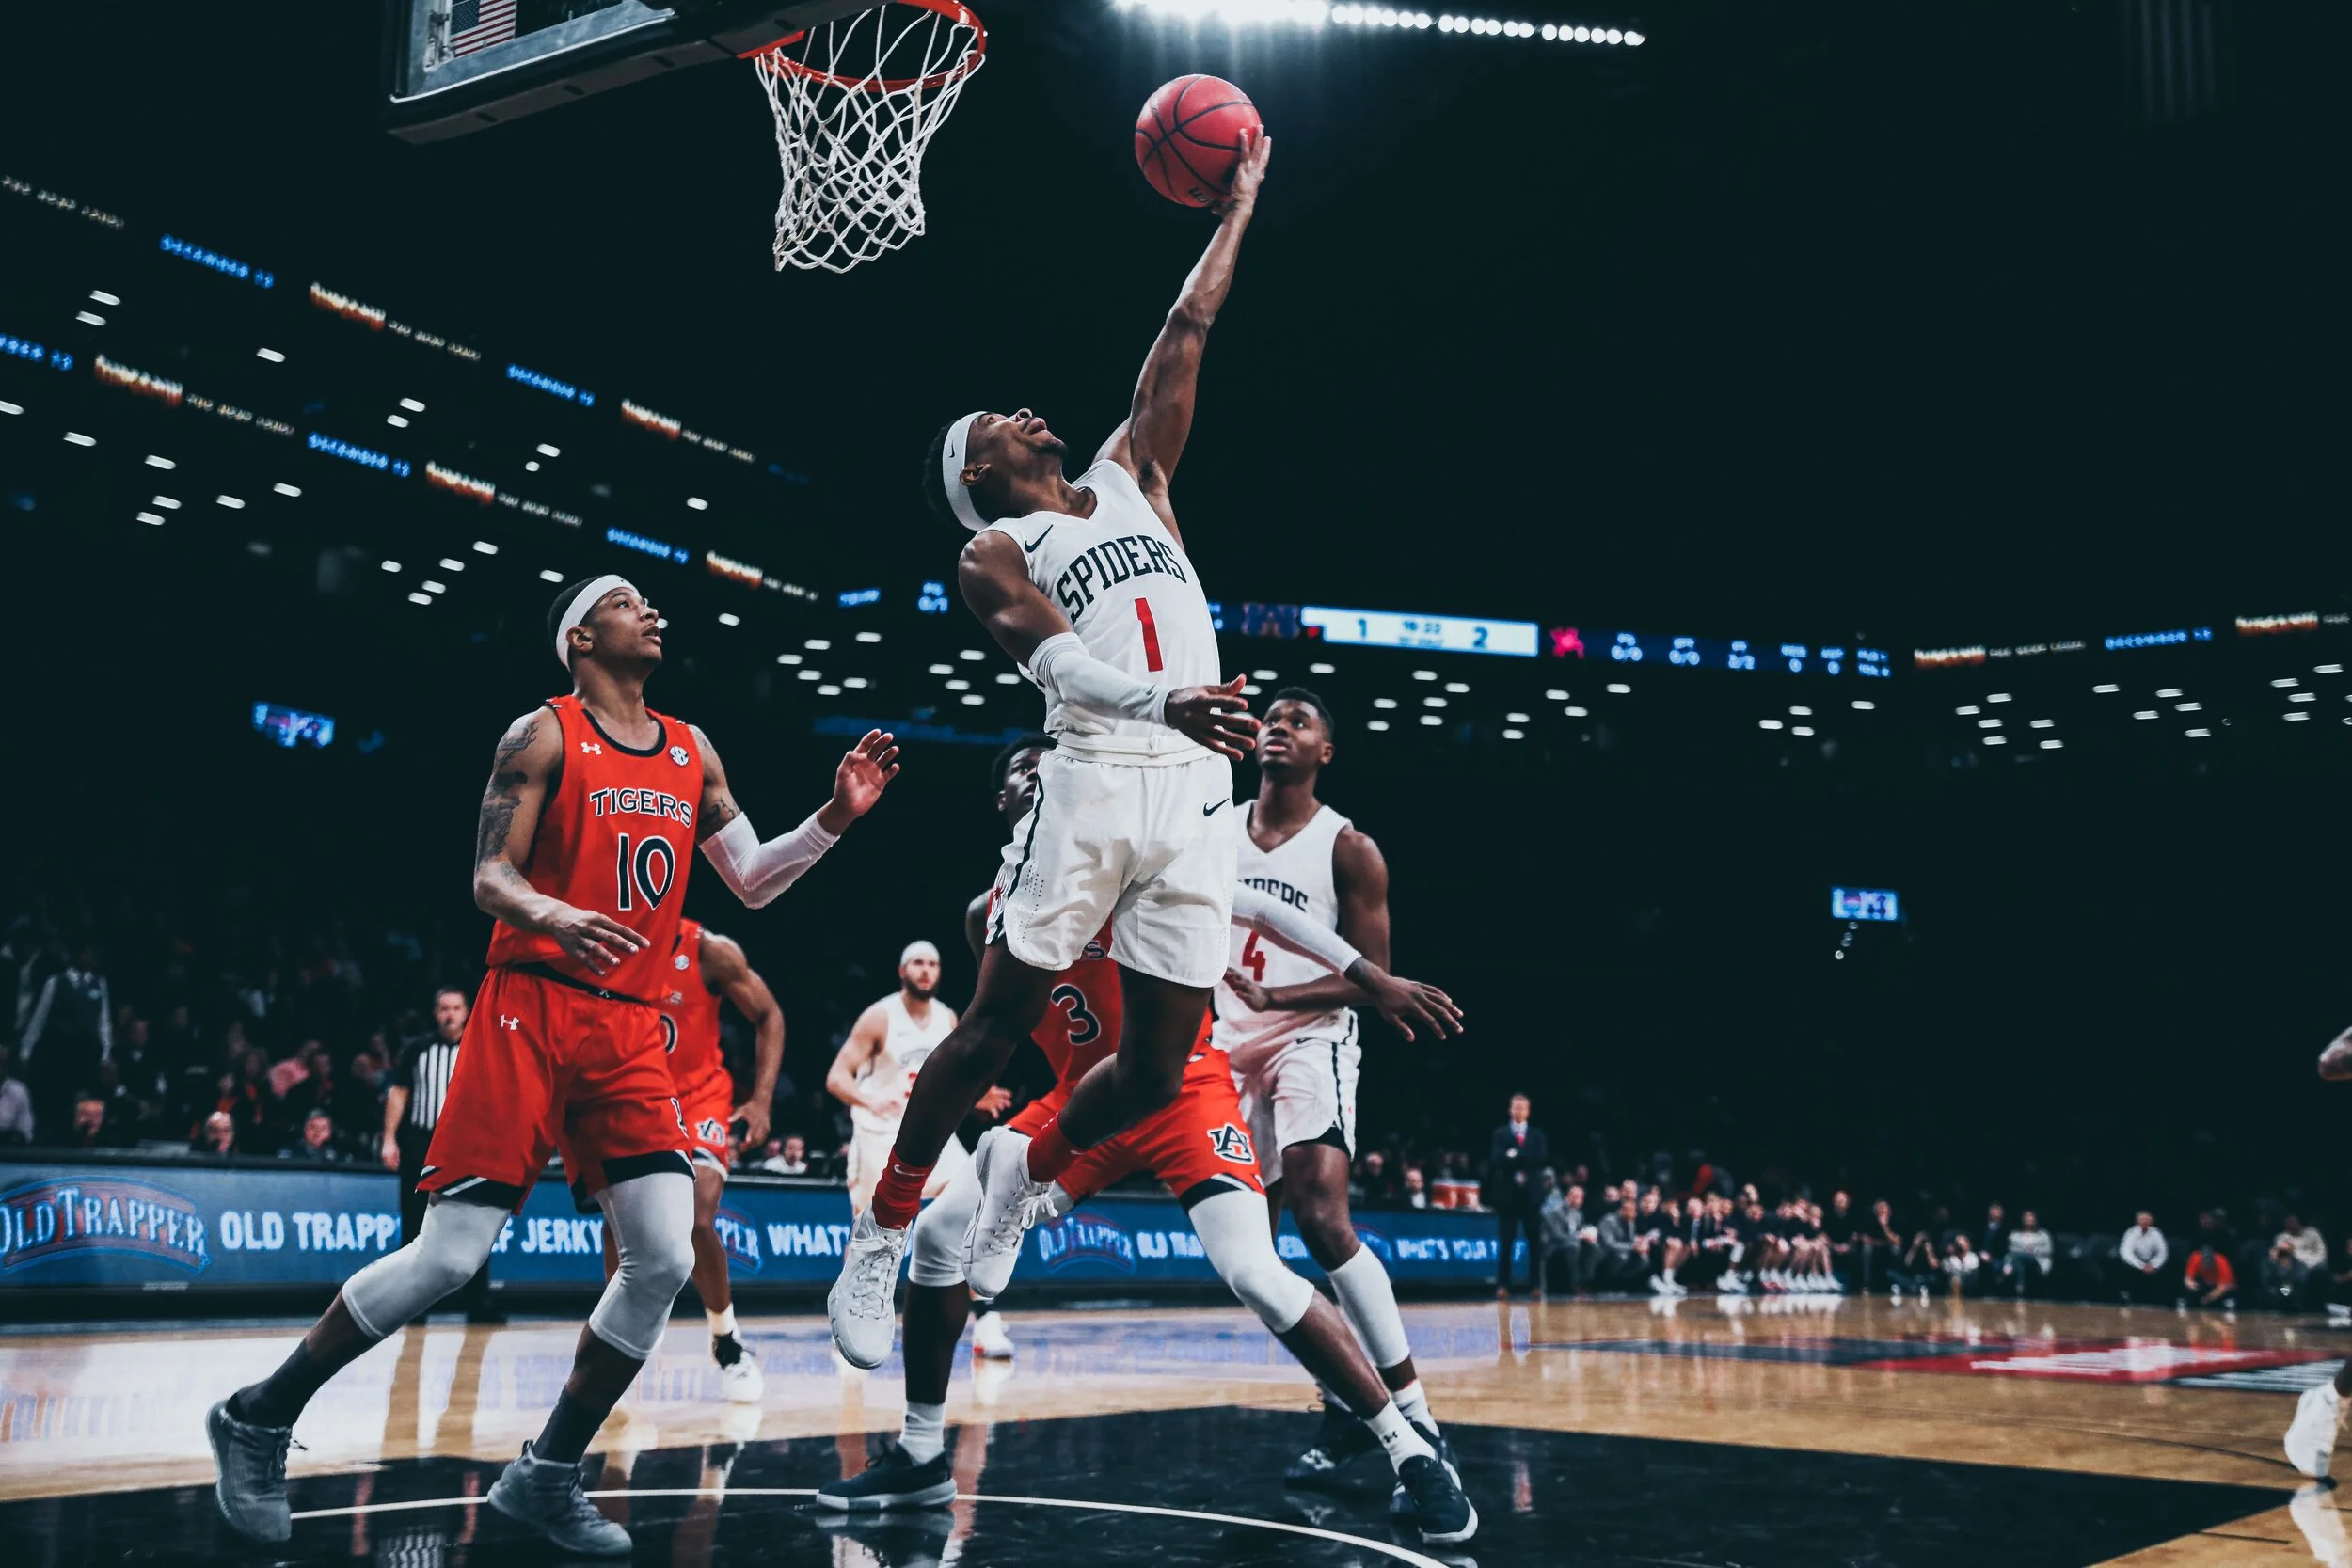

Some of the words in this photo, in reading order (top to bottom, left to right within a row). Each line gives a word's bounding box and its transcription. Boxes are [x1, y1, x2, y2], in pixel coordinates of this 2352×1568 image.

[1057, 534, 1187, 625] SPIDERS
[1134, 597, 1164, 672] 1
[1357, 618, 1368, 639] 1
[1472, 626, 1489, 649] 2
[589, 787, 693, 828] TIGERS
[616, 832, 675, 911] 10
[1242, 928, 1267, 982] 4
[1050, 983, 1101, 1046] 3
[56, 1185, 209, 1257] TRAPPER
[220, 1210, 285, 1251] OLD
[292, 1212, 402, 1252] TRAPP
[520, 1217, 604, 1254] JERKY
